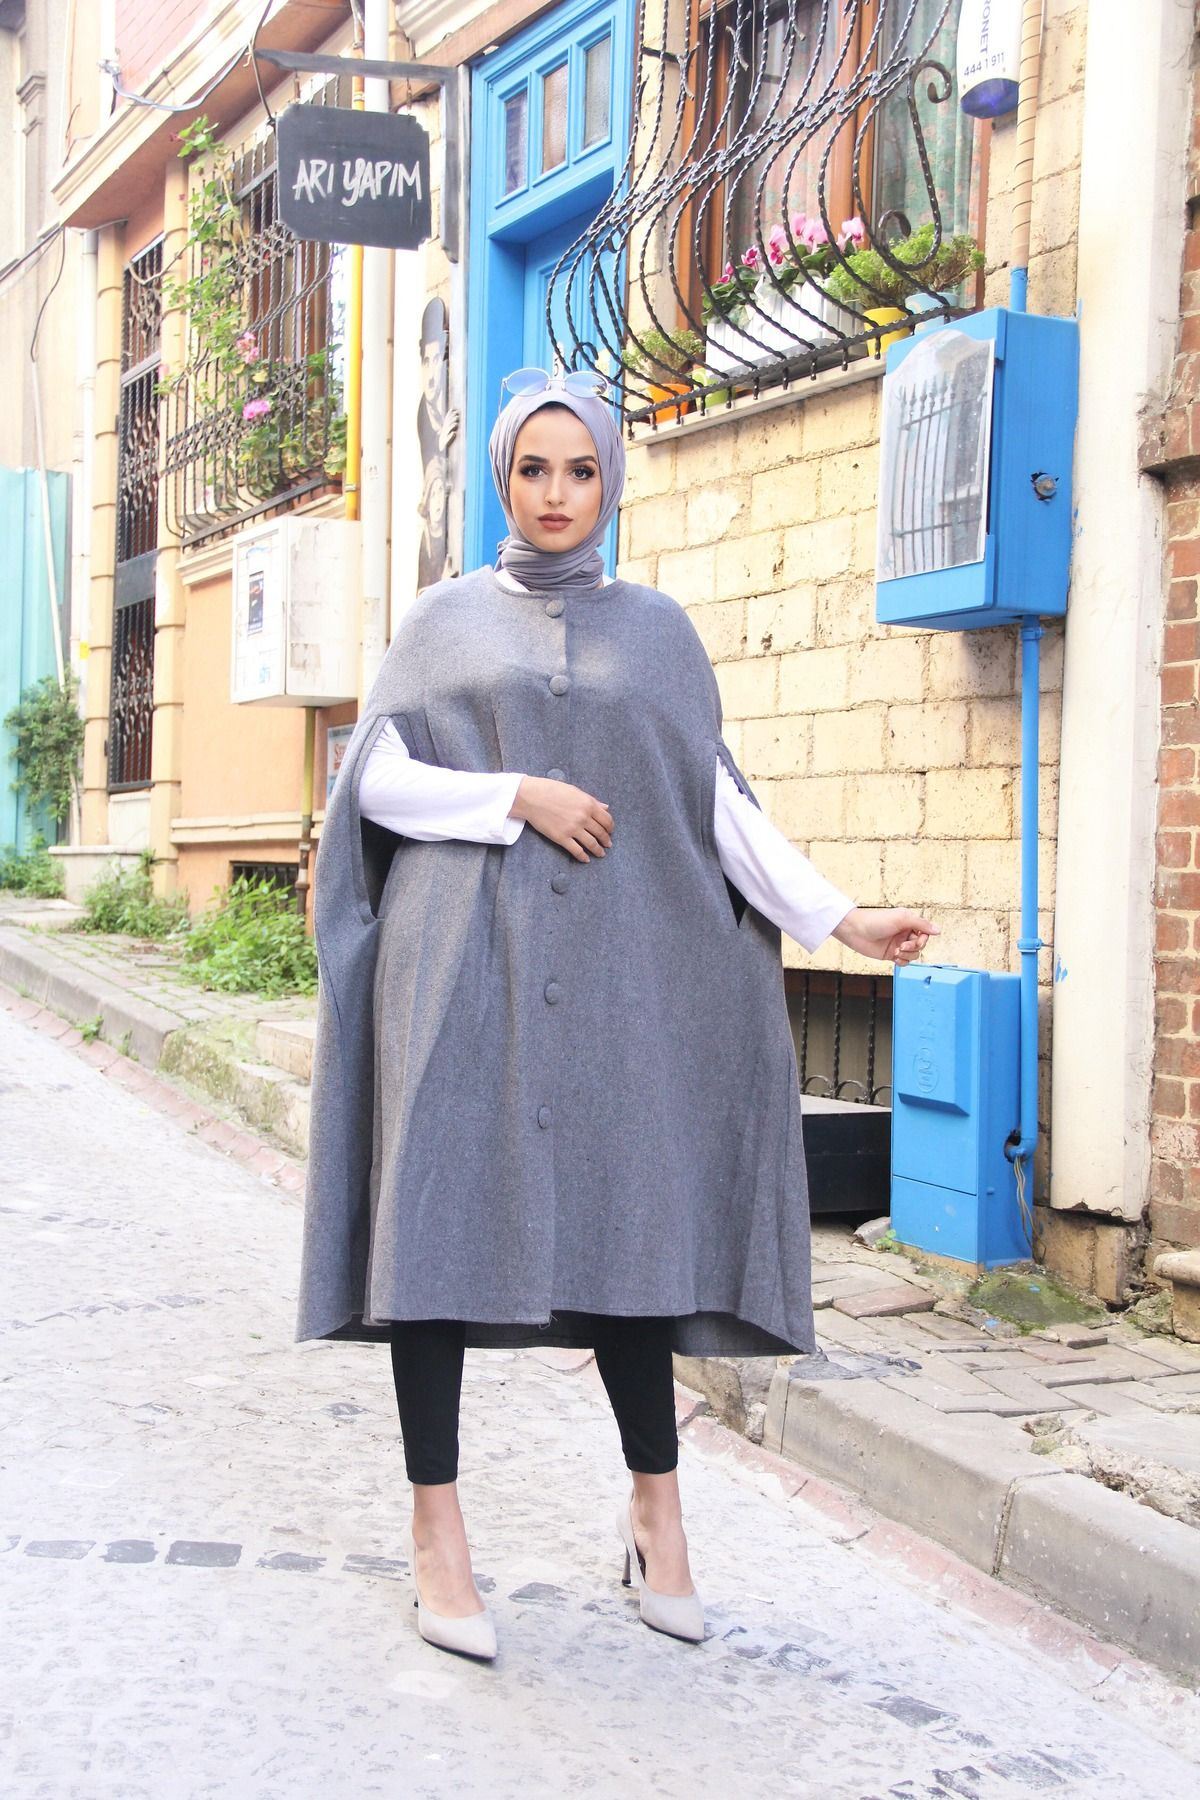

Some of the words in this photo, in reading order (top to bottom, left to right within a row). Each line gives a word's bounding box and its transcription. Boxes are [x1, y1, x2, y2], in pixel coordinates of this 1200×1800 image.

[963, 61, 983, 76] 444
[292, 159, 335, 204] ARI
[342, 158, 422, 207] YAPIM
